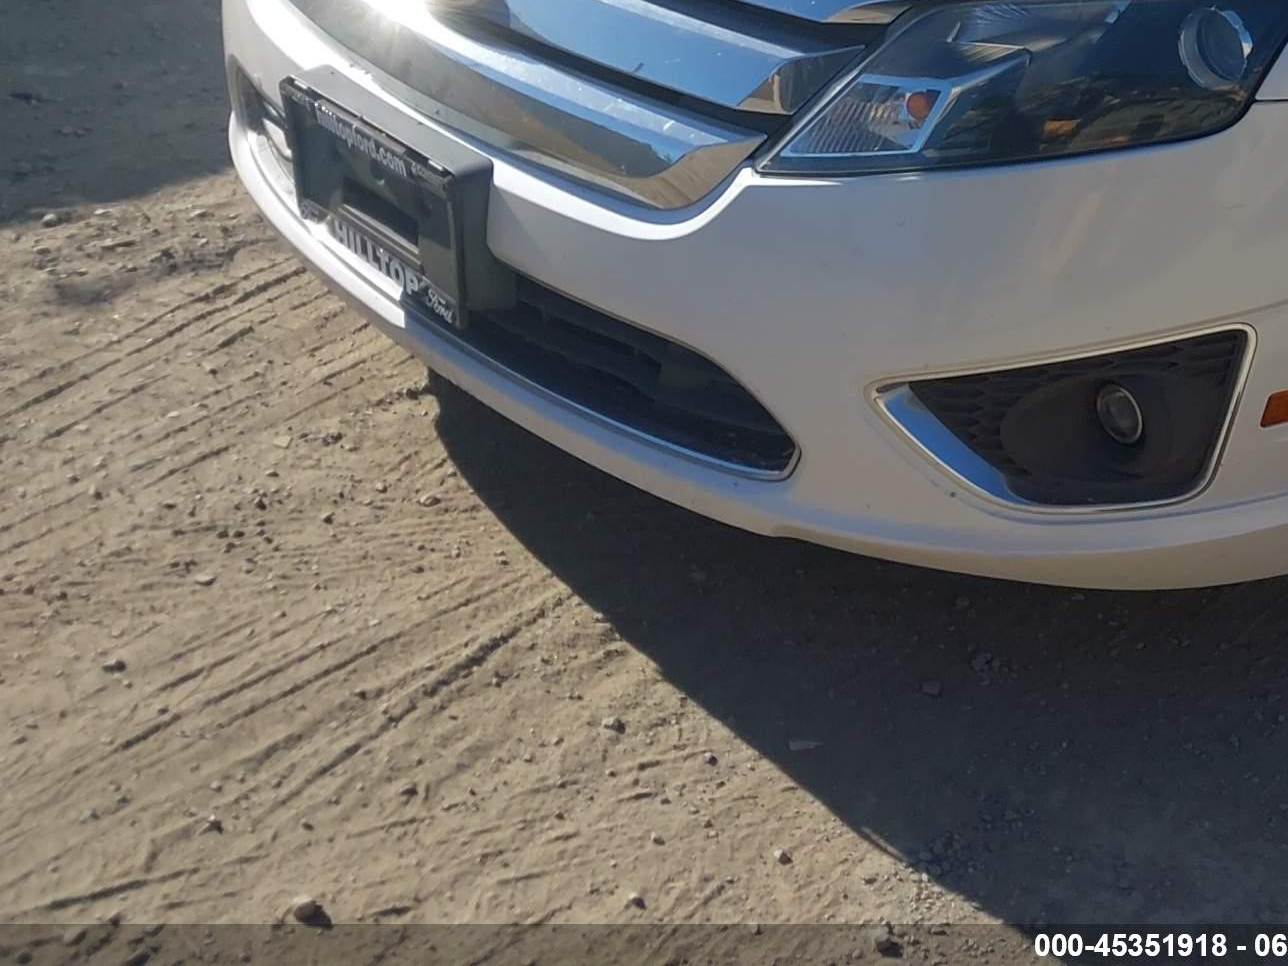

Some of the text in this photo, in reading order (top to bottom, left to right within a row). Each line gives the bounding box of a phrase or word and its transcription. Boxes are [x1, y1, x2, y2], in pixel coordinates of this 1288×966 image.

[314, 102, 407, 177] hilltopford.com
[334, 218, 454, 324] HILLTOP Ford
